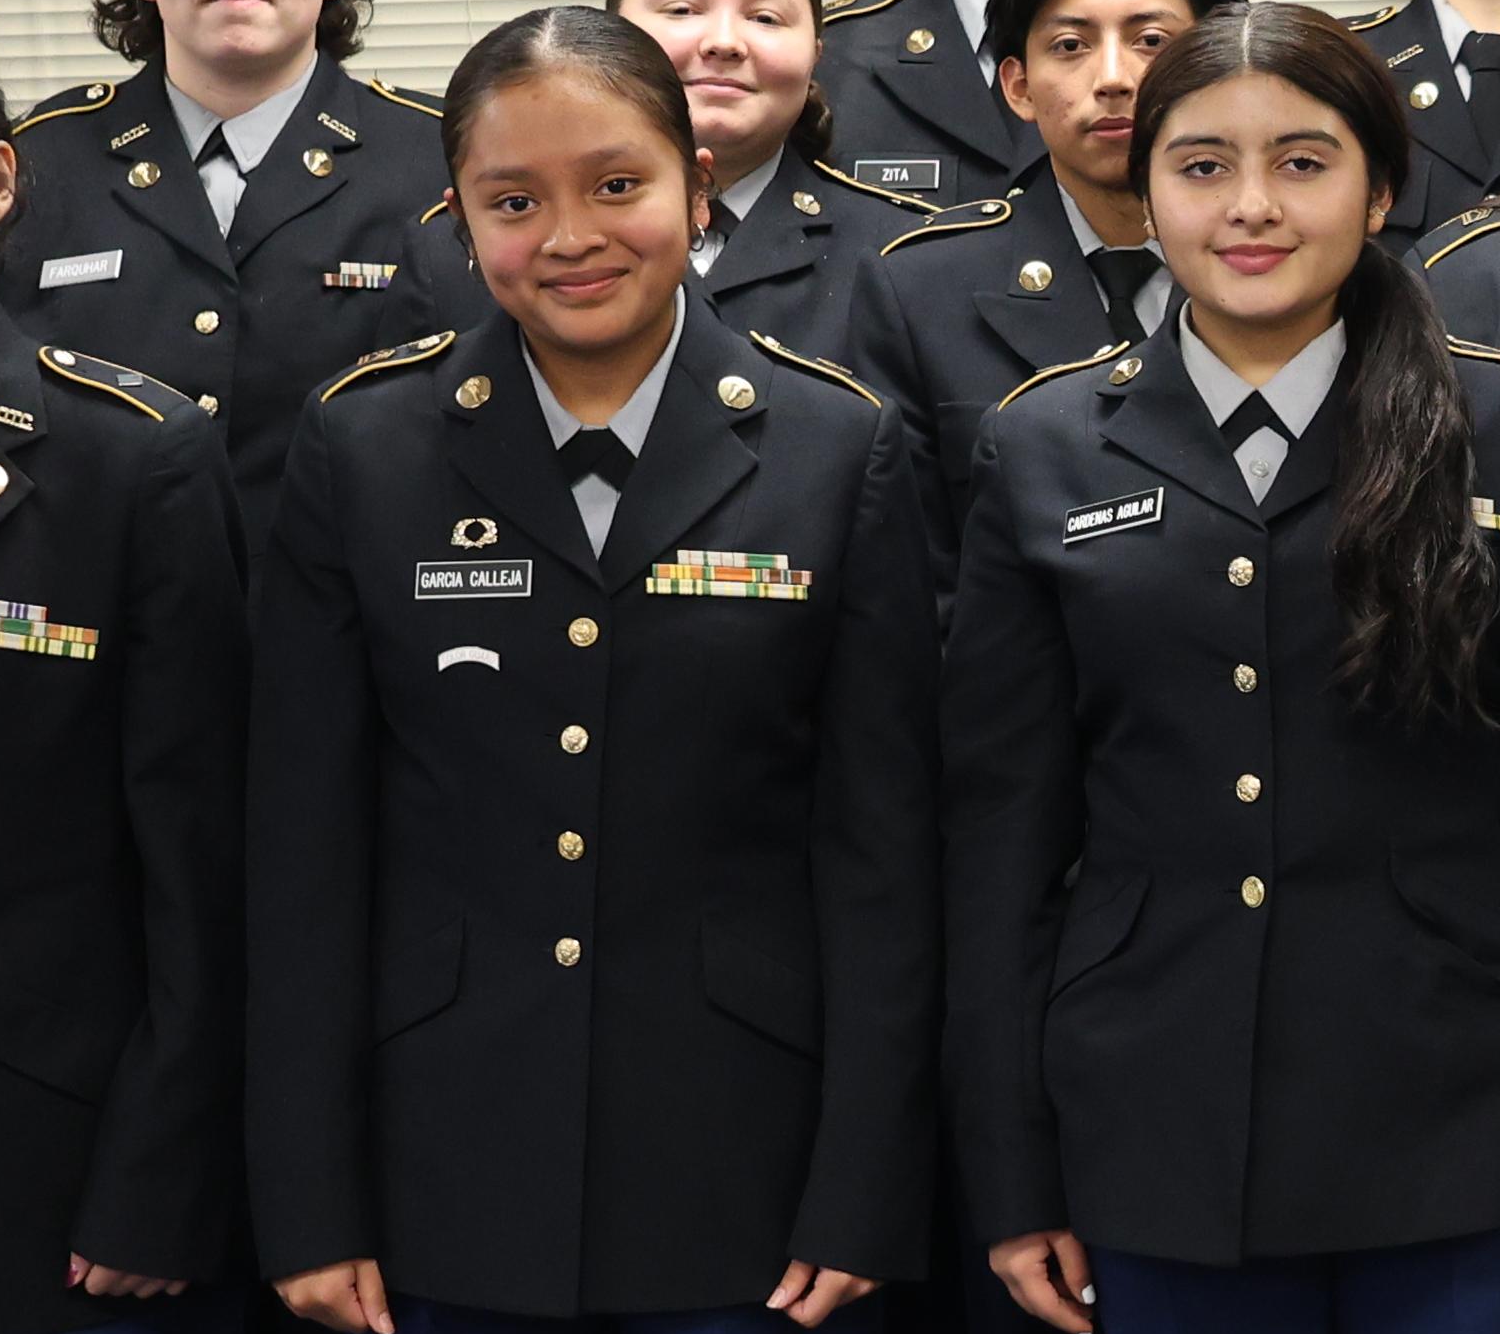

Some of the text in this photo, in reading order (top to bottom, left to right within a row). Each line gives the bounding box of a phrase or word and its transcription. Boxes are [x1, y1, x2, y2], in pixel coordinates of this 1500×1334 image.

[881, 167, 909, 182] ZITA
[49, 259, 109, 280] FARQUHAR
[1067, 497, 1155, 533] CARDENAS AGUILAR
[420, 569, 523, 589] GARCIA CALLEJA
